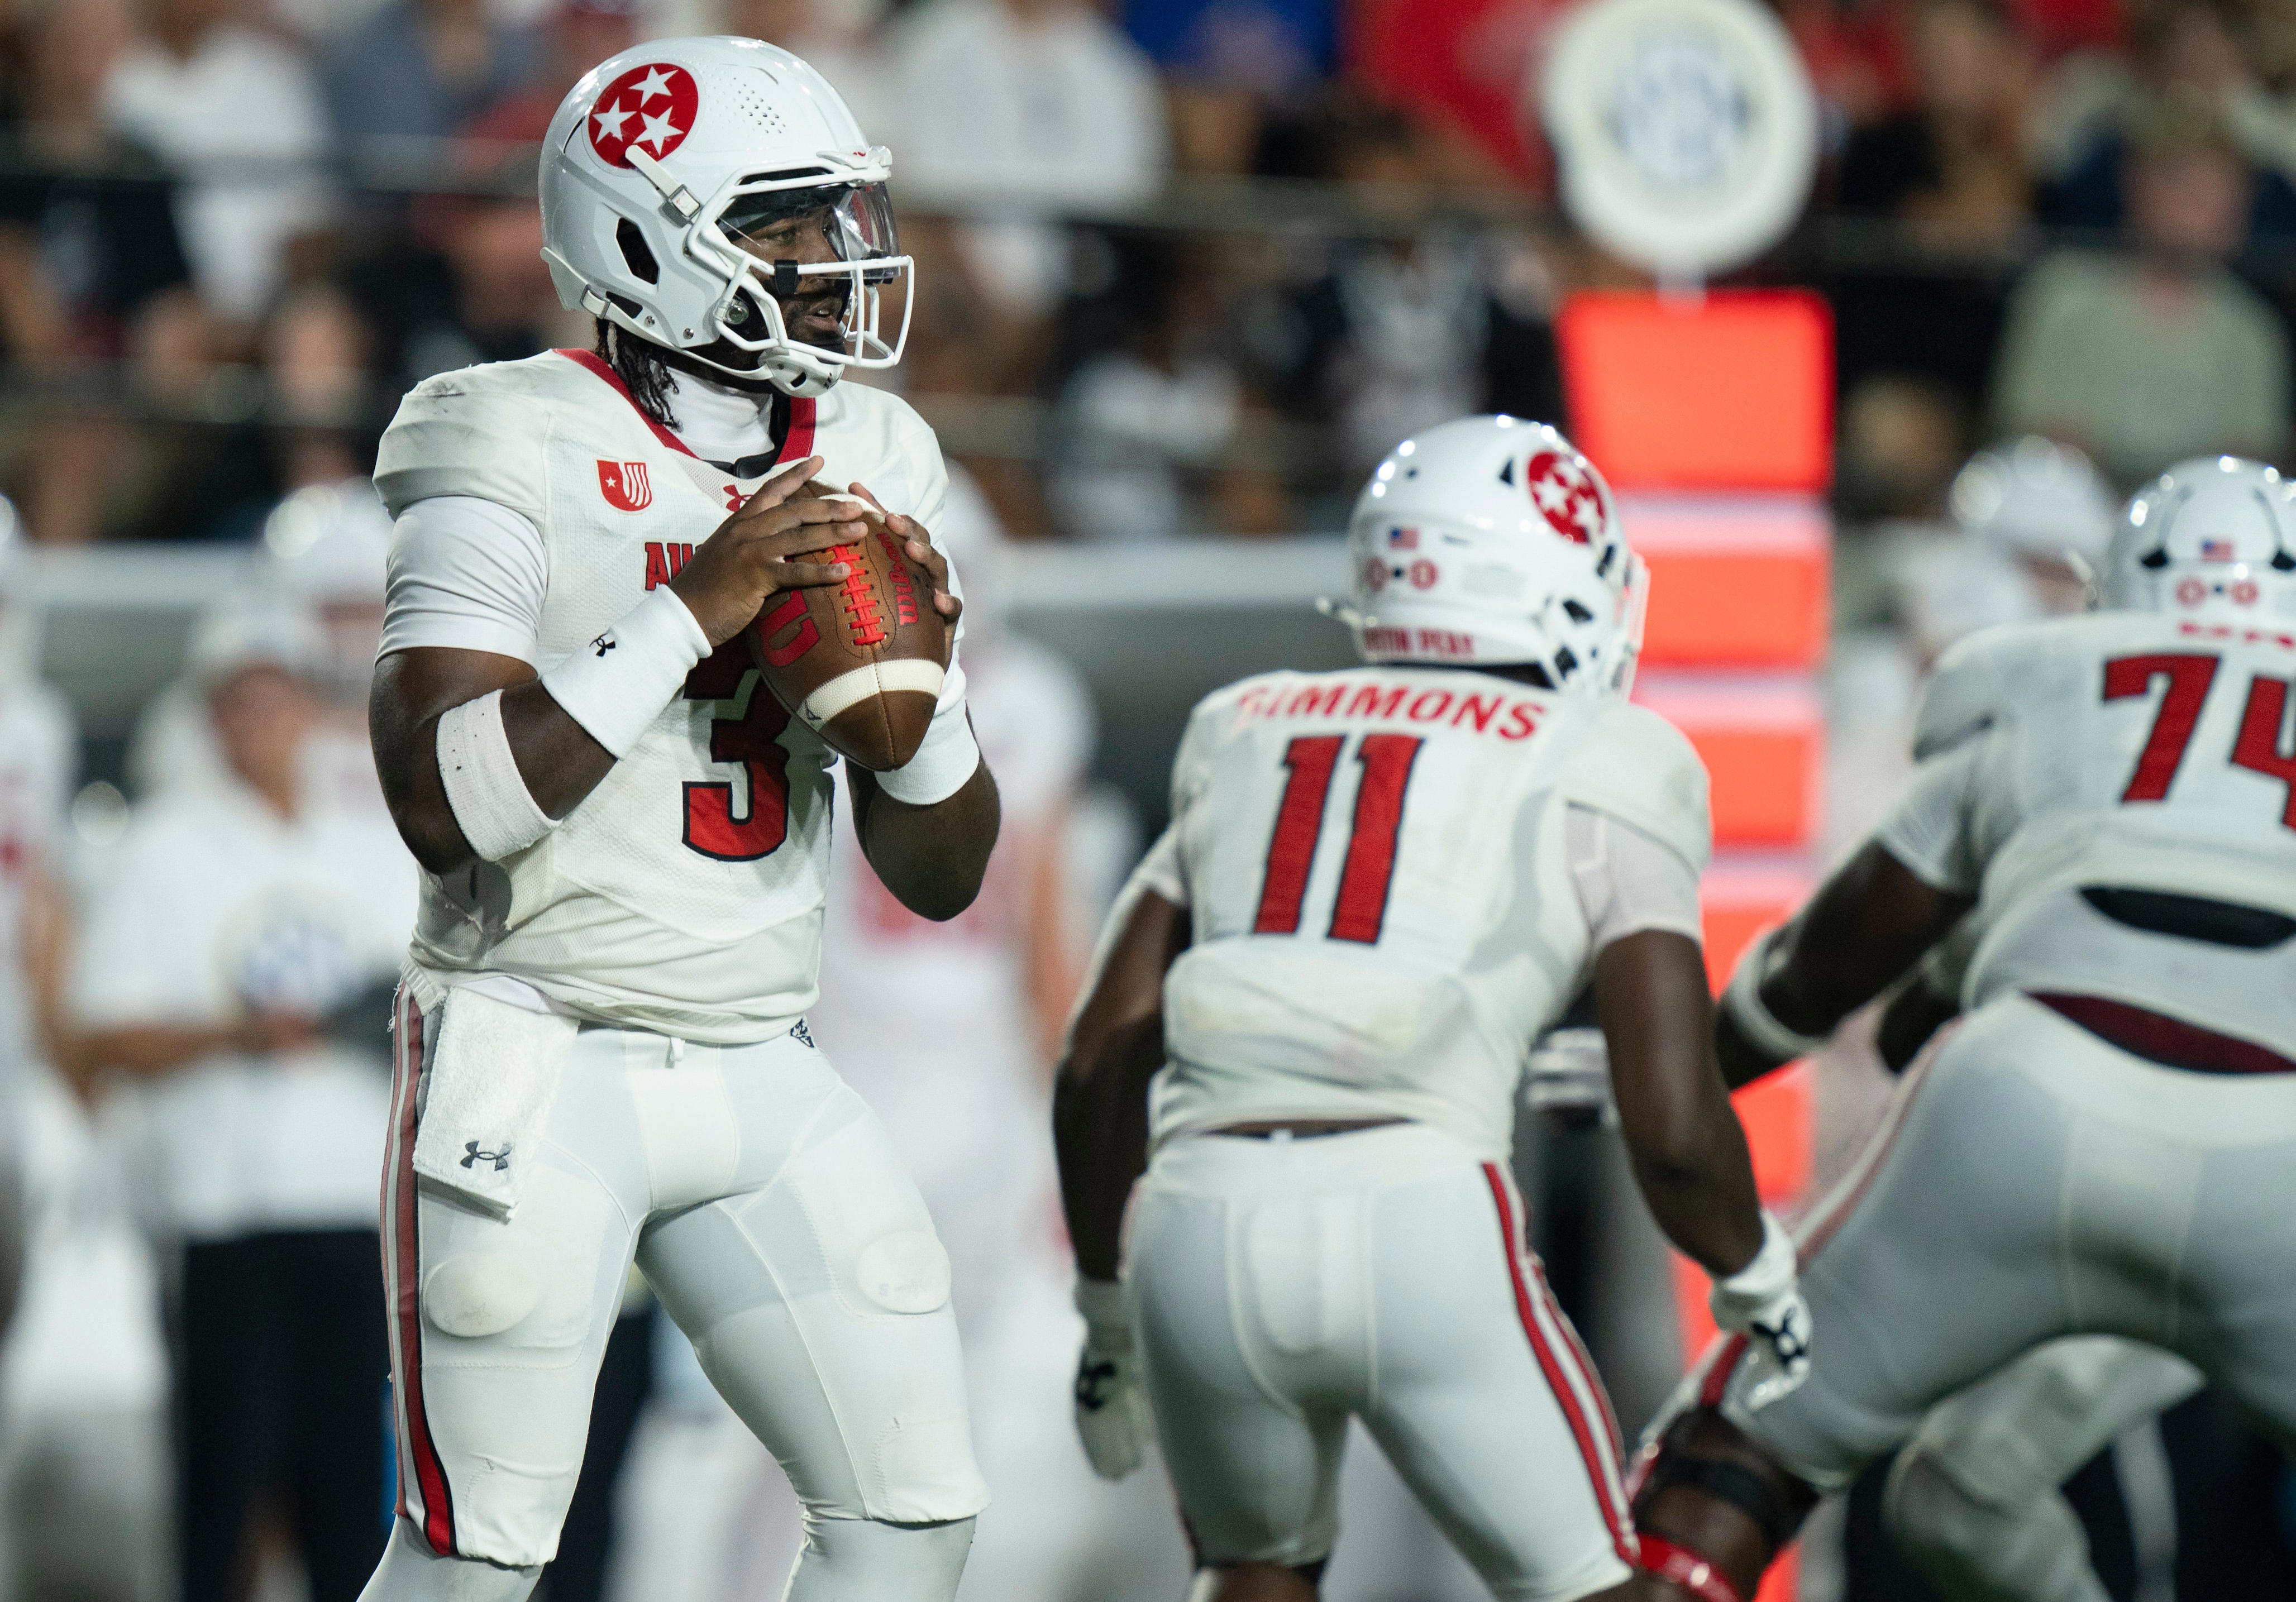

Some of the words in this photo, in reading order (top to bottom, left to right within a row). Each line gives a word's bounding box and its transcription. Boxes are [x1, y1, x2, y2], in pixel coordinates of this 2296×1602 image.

[682, 620, 790, 862] 3
[1235, 682, 1546, 742] SIMMONS
[2101, 651, 2296, 832] 74
[1251, 733, 1425, 945] 11
